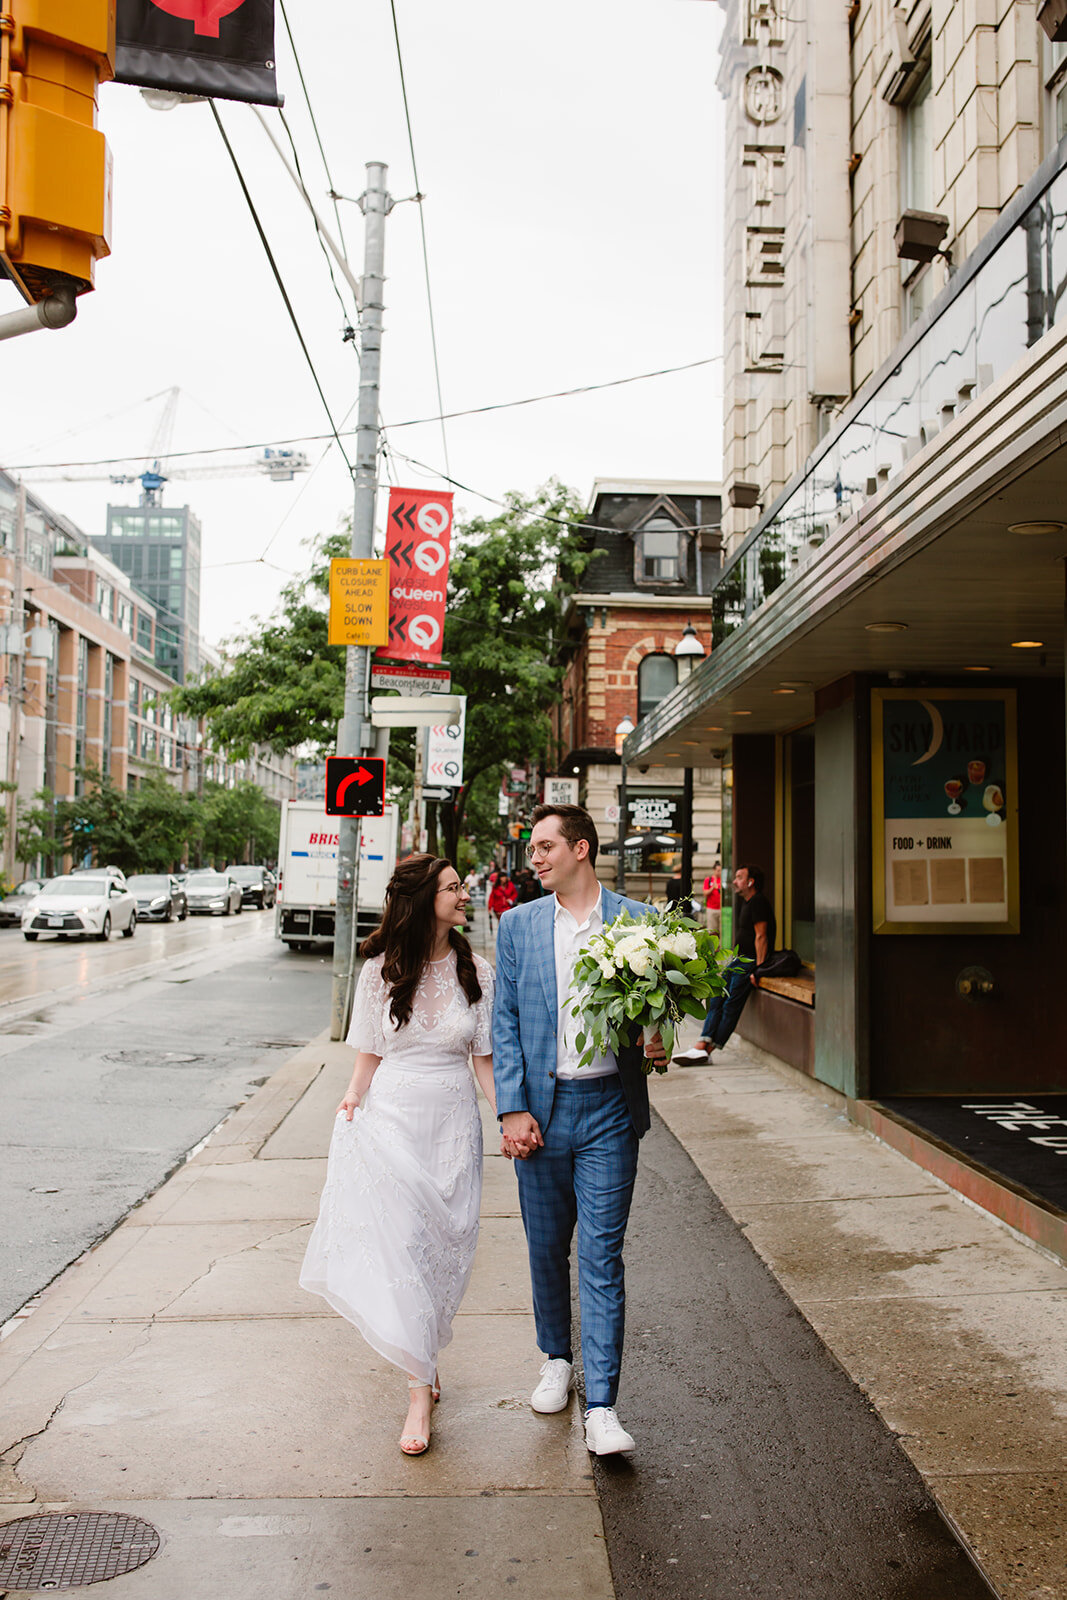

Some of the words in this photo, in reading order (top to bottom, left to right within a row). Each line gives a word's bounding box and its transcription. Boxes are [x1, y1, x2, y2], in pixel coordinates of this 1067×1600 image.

[336, 567, 358, 576] CURB
[360, 568, 383, 576] LANE
[340, 578, 378, 586] CLOSURE
[344, 588, 374, 597] AHEAD
[345, 603, 373, 613] SLOW
[344, 616, 373, 626] DOWN
[379, 675, 430, 690] Beaconsfield
[431, 681, 442, 691] Av
[890, 722, 933, 753] SKY
[943, 721, 1001, 753] YARD
[309, 832, 366, 847] BRISL
[892, 837, 914, 850] FOOD
[927, 836, 952, 849] DRINK
